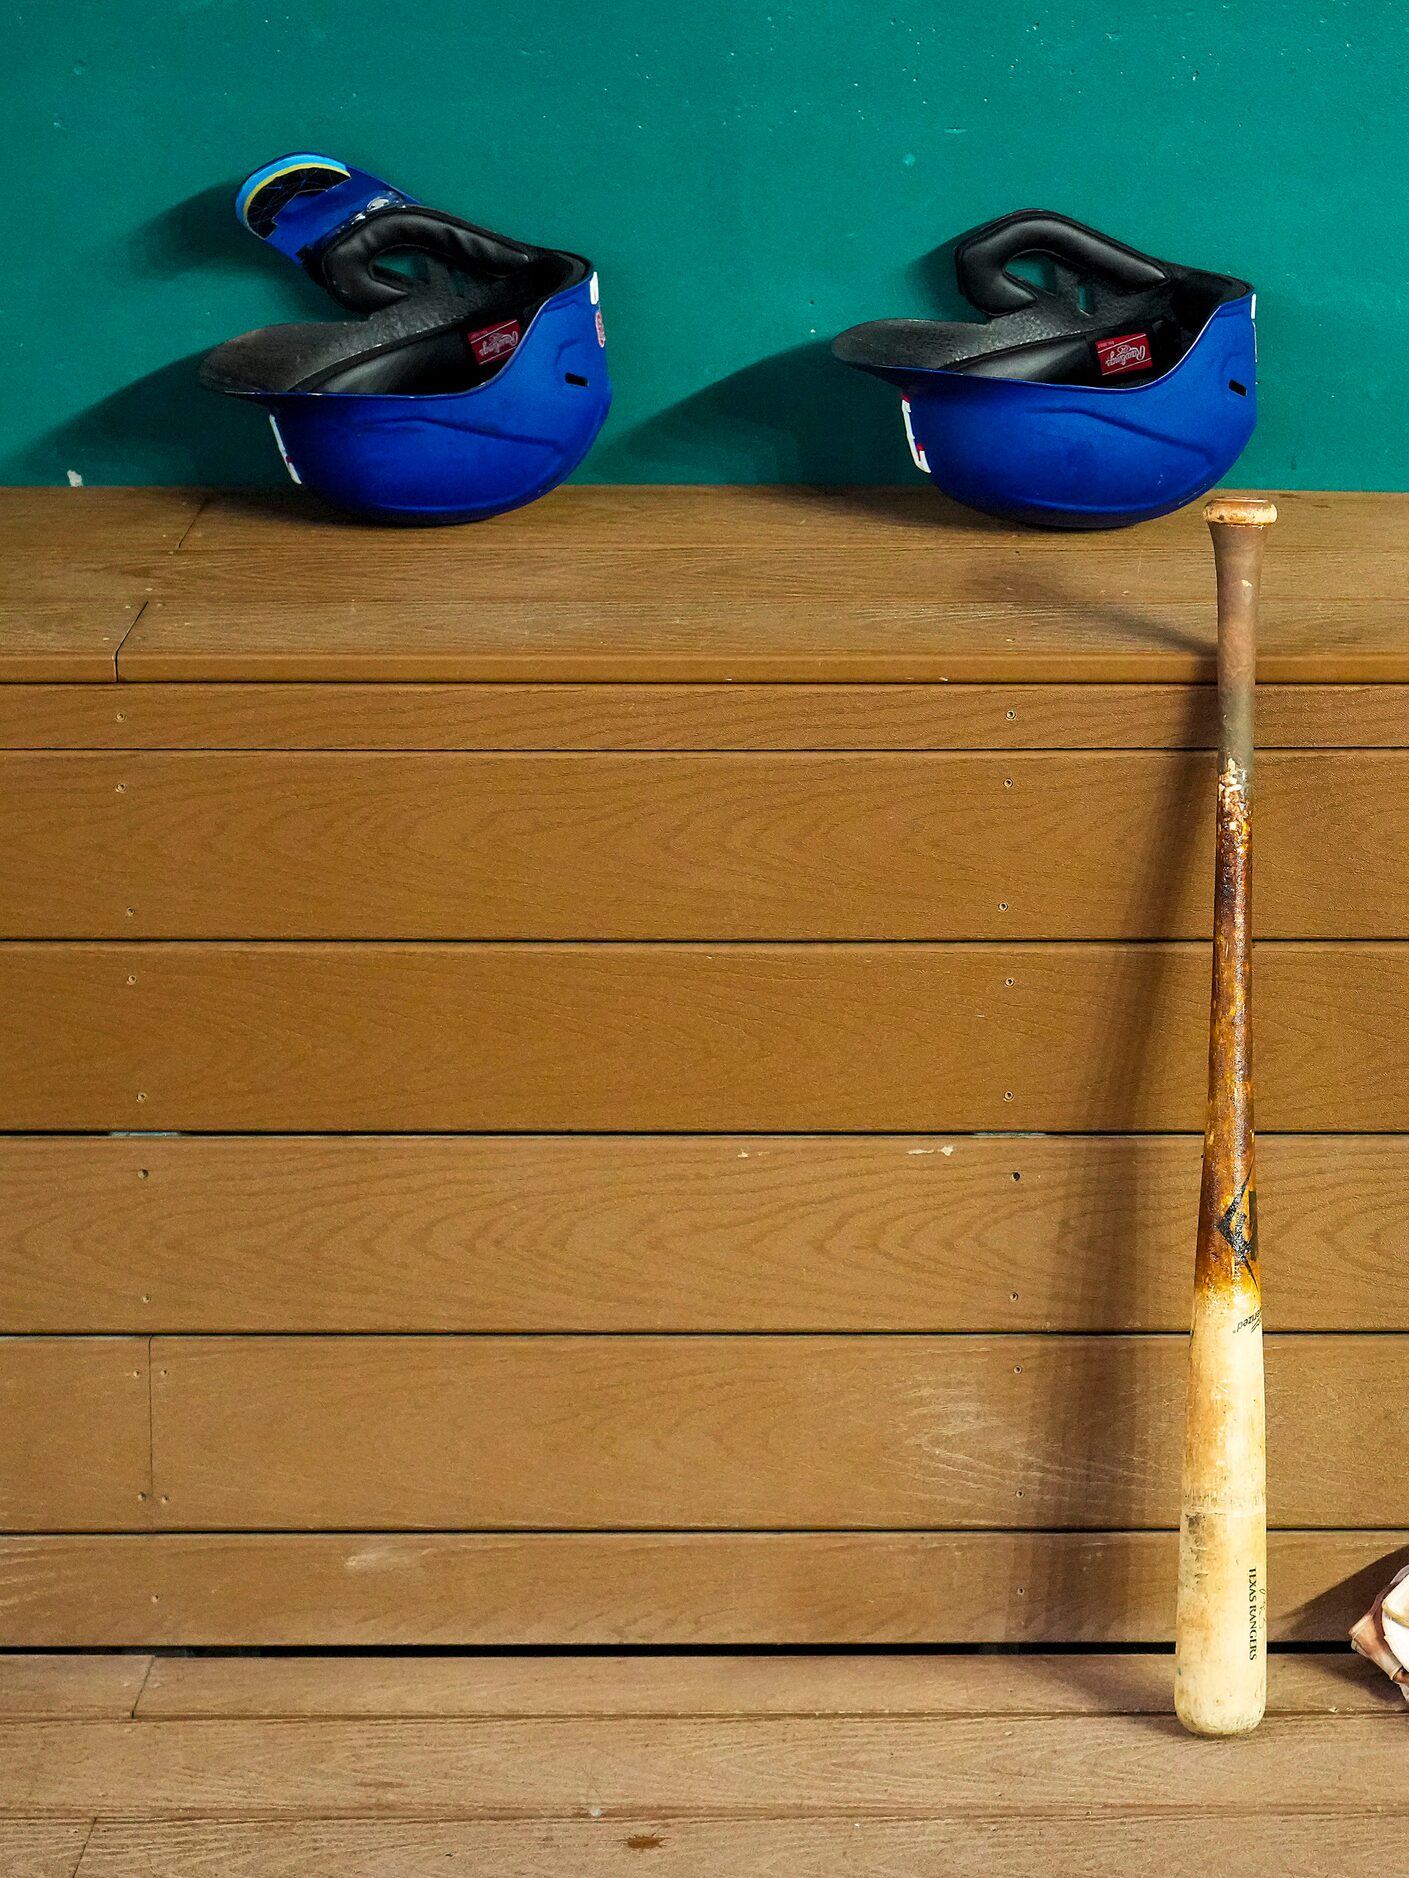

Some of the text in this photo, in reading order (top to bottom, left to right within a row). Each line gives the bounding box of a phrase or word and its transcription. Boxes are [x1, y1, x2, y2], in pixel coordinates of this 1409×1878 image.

[479, 331, 518, 355] Rawlings
[1105, 345, 1146, 367] Rawlings
[1249, 1568, 1257, 1661] TEXAS RANGERS
